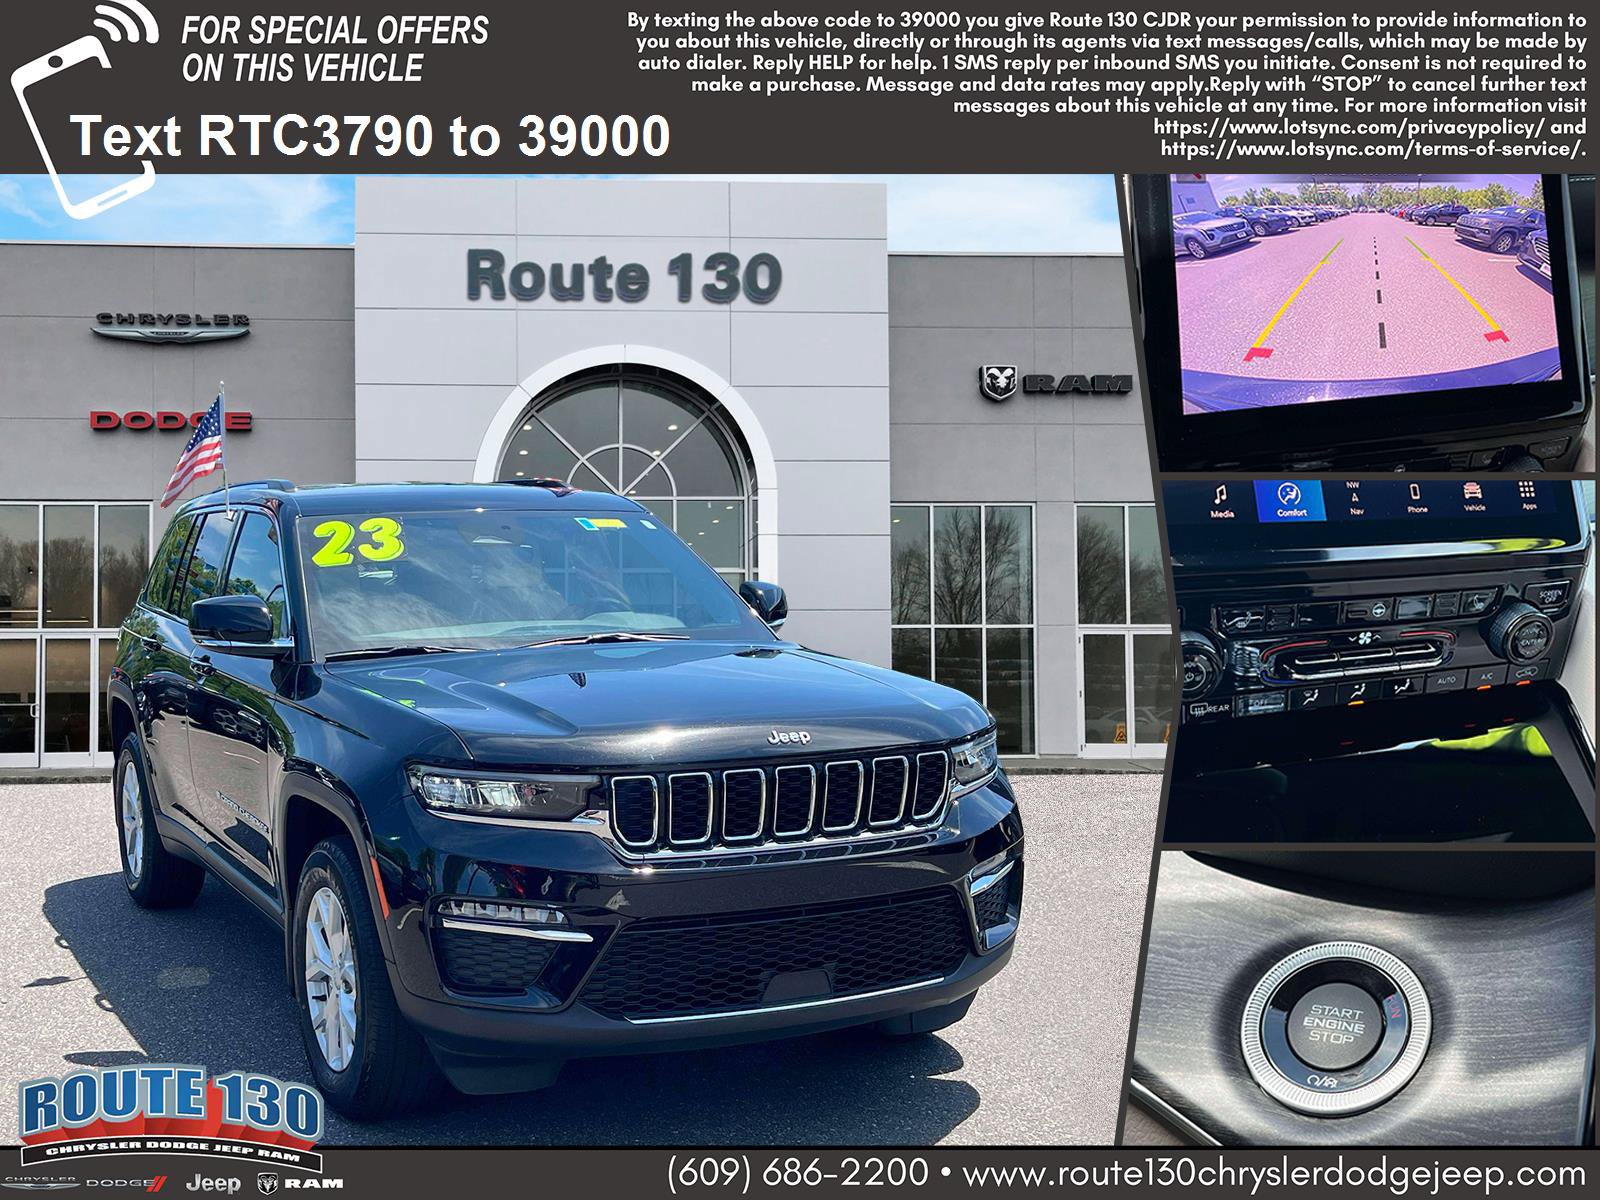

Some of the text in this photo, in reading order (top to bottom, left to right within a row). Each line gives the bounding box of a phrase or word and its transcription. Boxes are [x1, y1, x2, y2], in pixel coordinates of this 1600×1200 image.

[466, 248, 783, 305] Route 130
[96, 312, 249, 326] CHRYSLER
[1023, 374, 1133, 394] RAM
[1350, 507, 1364, 516] Nav
[1463, 504, 1486, 512] Vehicle
[1522, 502, 1538, 510] Apps
[1210, 510, 1236, 518] Media
[1276, 508, 1308, 517] Comfort
[312, 517, 404, 567] 23
[1437, 676, 1456, 684] AUTO
[1480, 672, 1493, 680] A/C
[1207, 704, 1230, 713] REAR
[767, 729, 812, 745] Jeep
[1310, 1004, 1364, 1020] START
[1303, 1016, 1366, 1034] ENGINE
[1308, 1030, 1355, 1045] STOP
